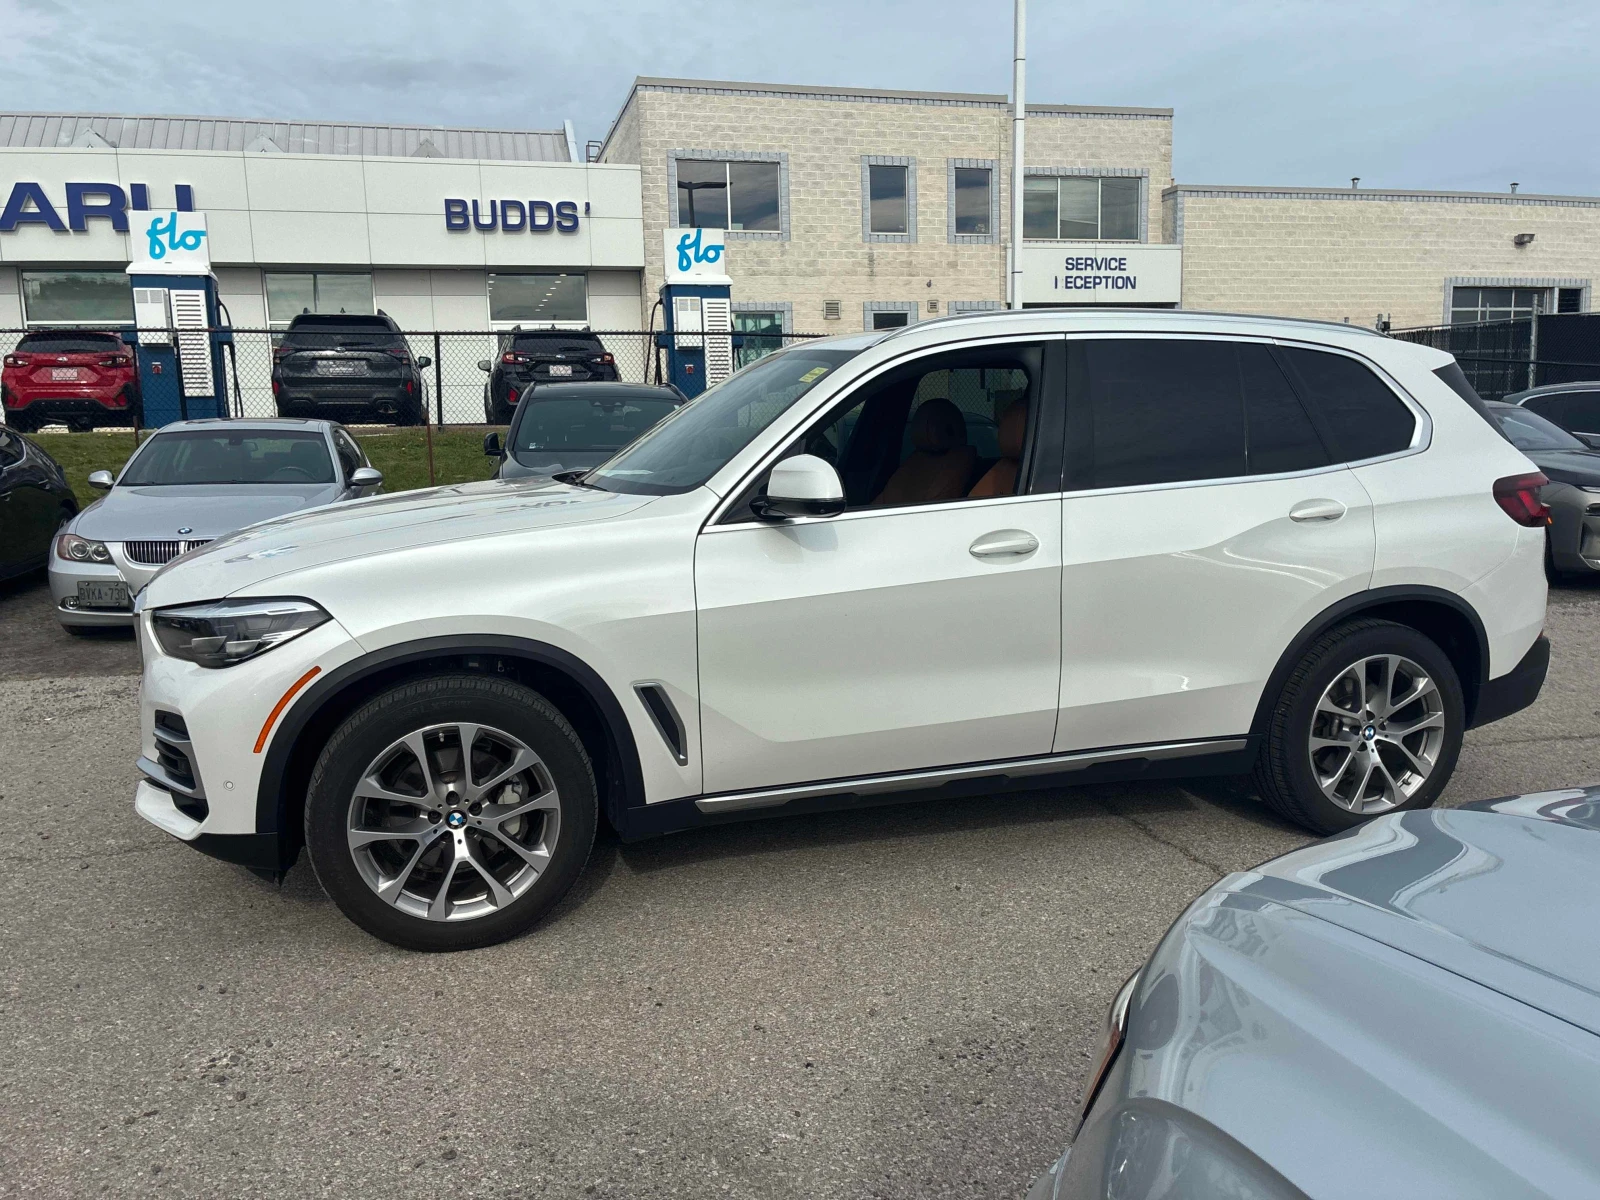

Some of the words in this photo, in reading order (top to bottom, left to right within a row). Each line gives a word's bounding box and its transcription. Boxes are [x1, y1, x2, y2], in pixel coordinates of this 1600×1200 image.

[444, 198, 591, 232] BUDDS'
[146, 211, 207, 260] flo
[676, 228, 725, 272] flo
[1065, 257, 1127, 271] SERVICE
